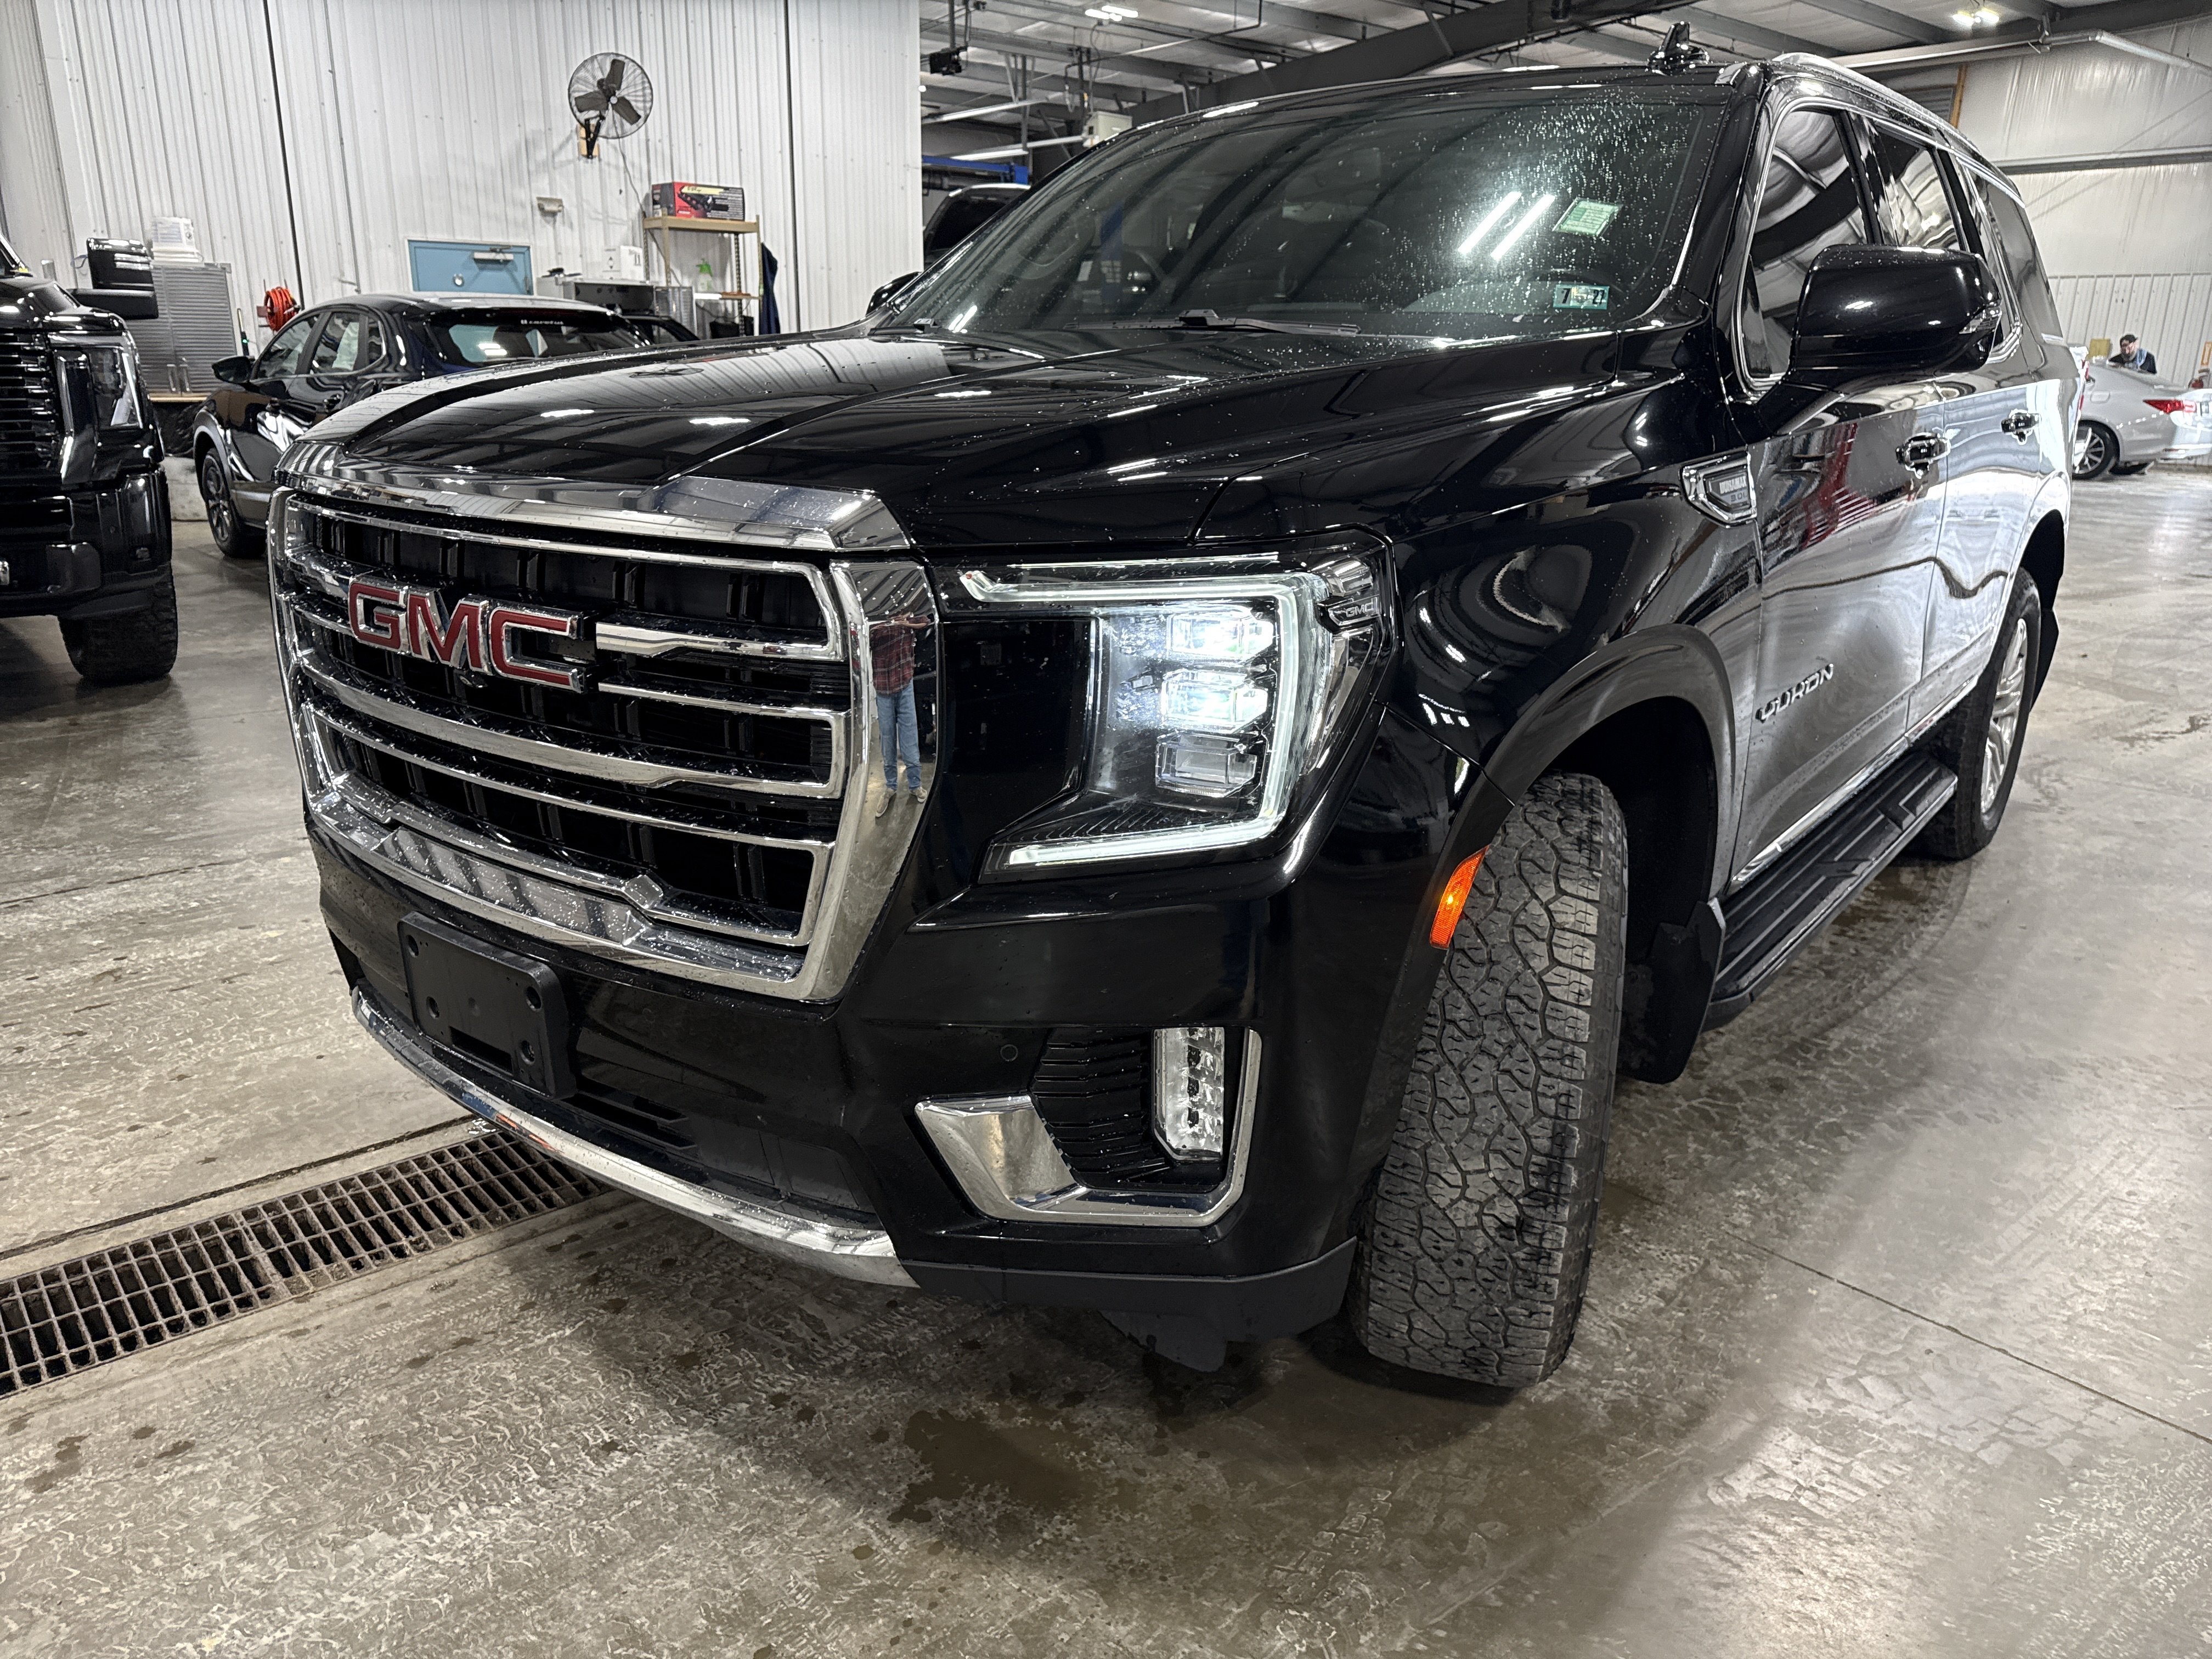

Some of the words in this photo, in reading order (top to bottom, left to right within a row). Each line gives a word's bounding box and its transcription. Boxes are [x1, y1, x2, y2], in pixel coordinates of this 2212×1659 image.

[1562, 287, 1571, 304] 7
[1593, 289, 1605, 305] 27
[1719, 475, 1747, 494] DURAMAX
[1346, 602, 1374, 618] GMC
[348, 577, 584, 694] GMC
[1755, 663, 1834, 723] YUKON
